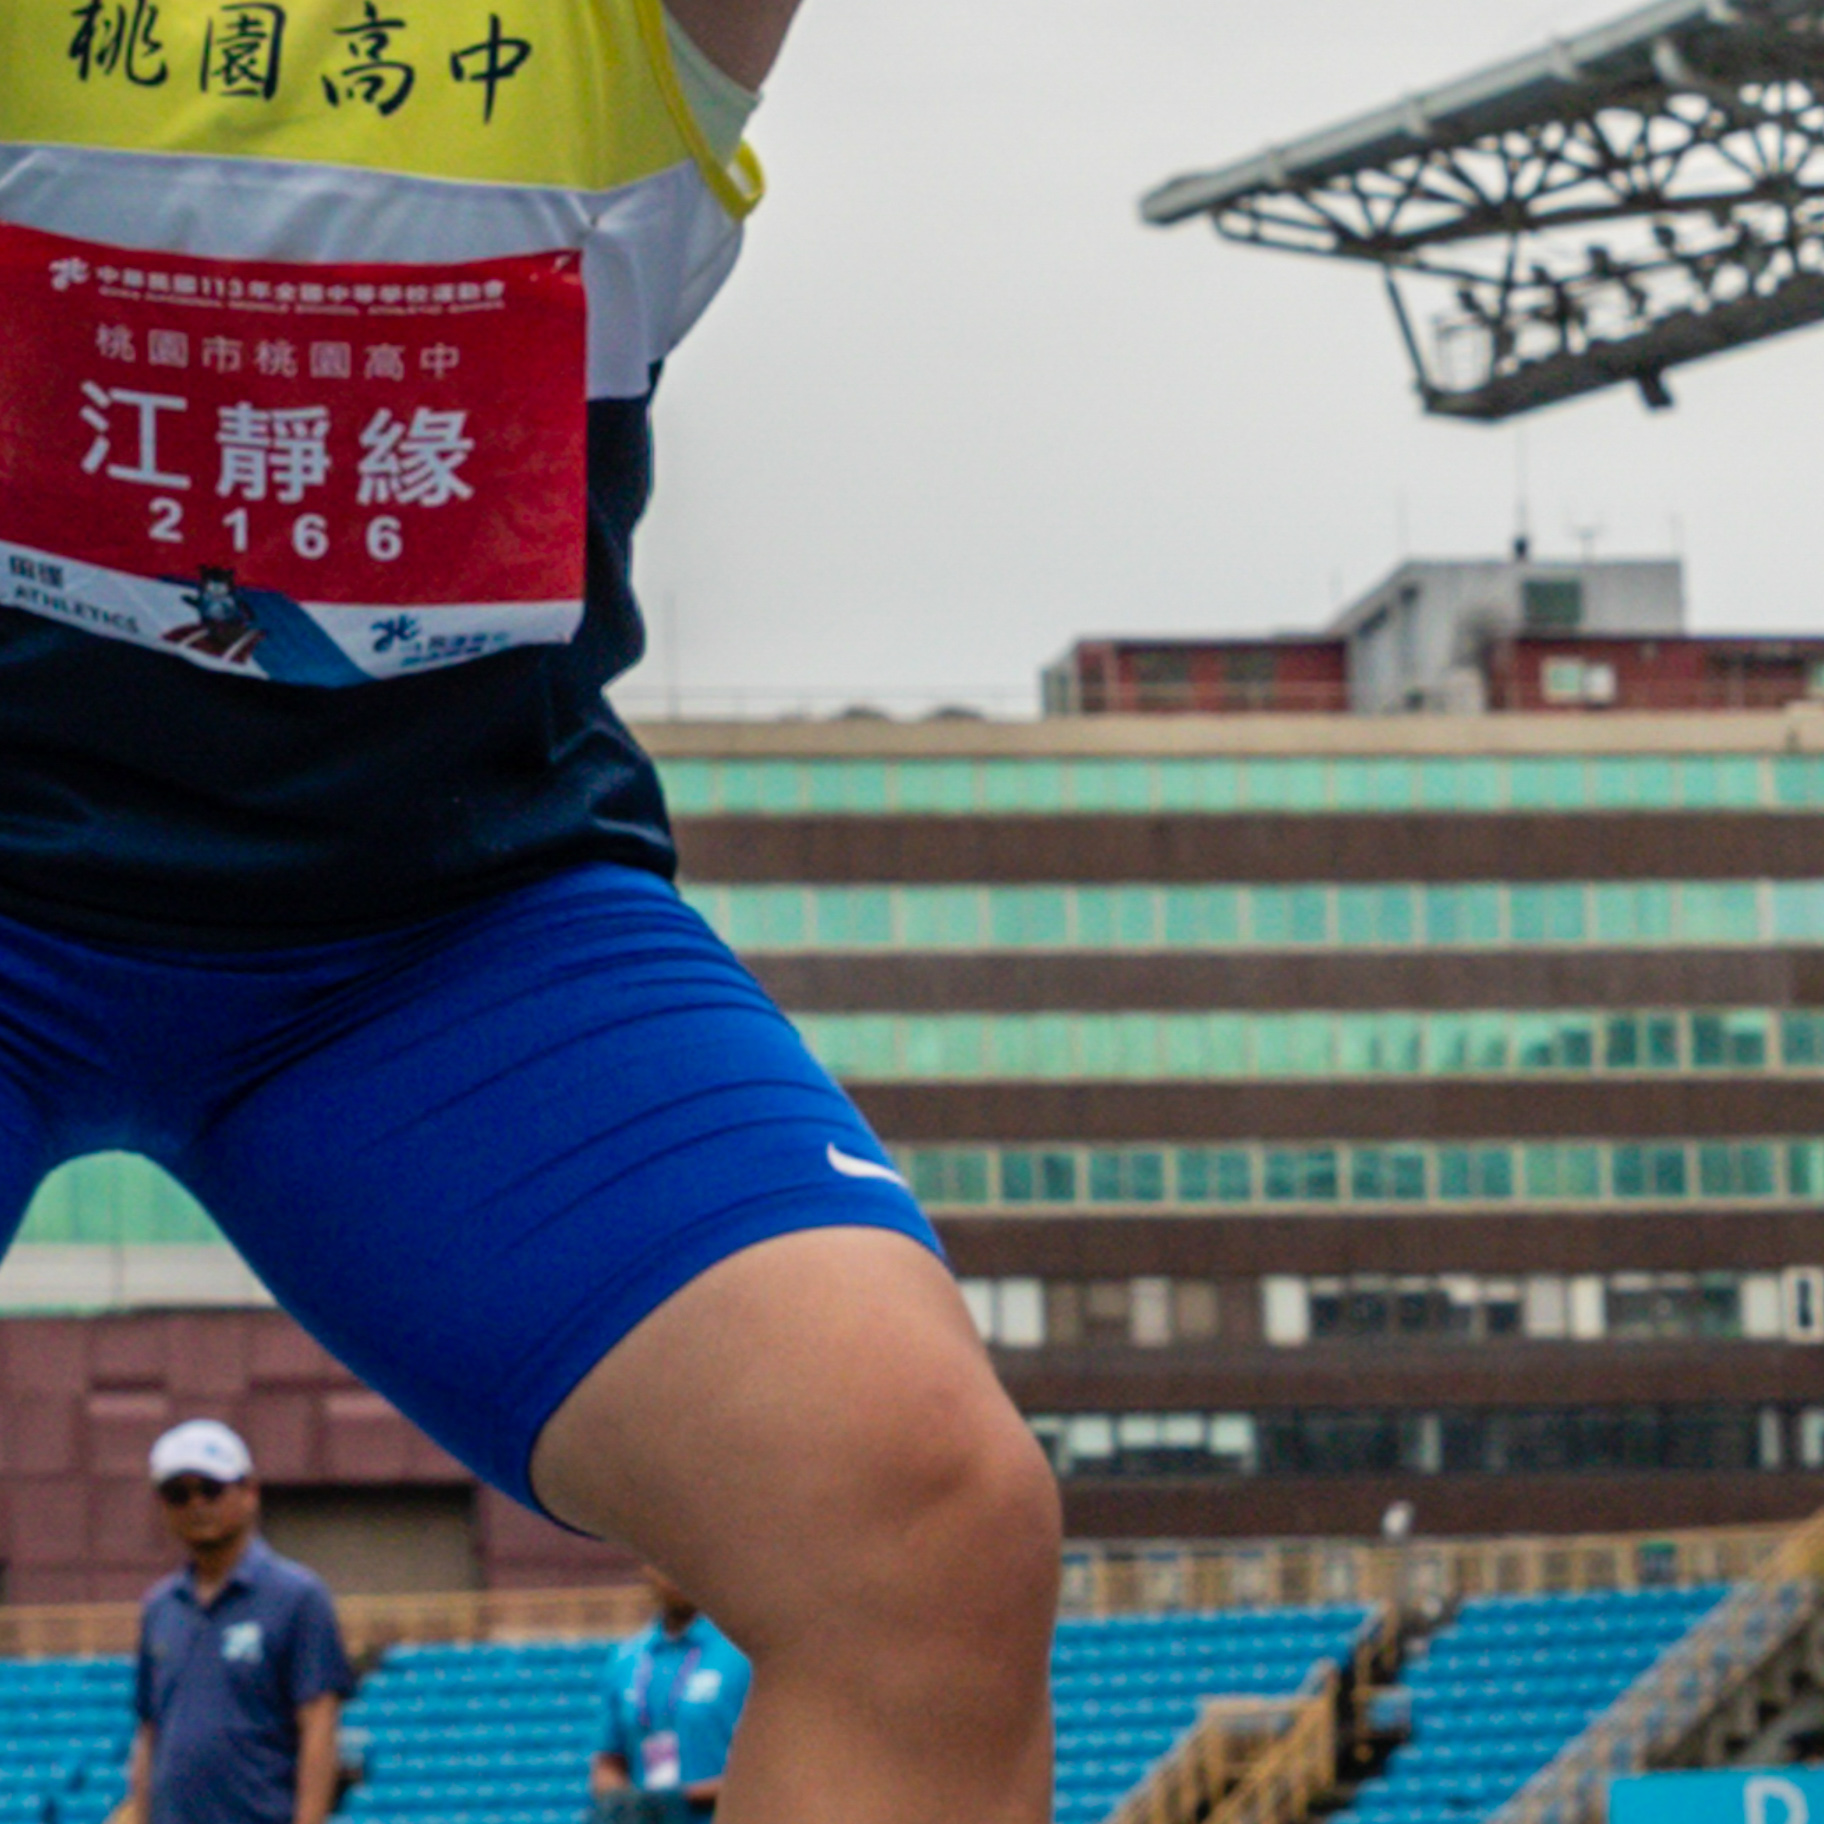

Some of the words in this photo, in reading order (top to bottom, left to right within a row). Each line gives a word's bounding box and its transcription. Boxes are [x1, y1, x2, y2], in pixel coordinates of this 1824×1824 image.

[96, 324, 460, 380] 桃園市桃園高中
[80, 381, 475, 507] 江靜緣
[148, 498, 403, 560] 2166
